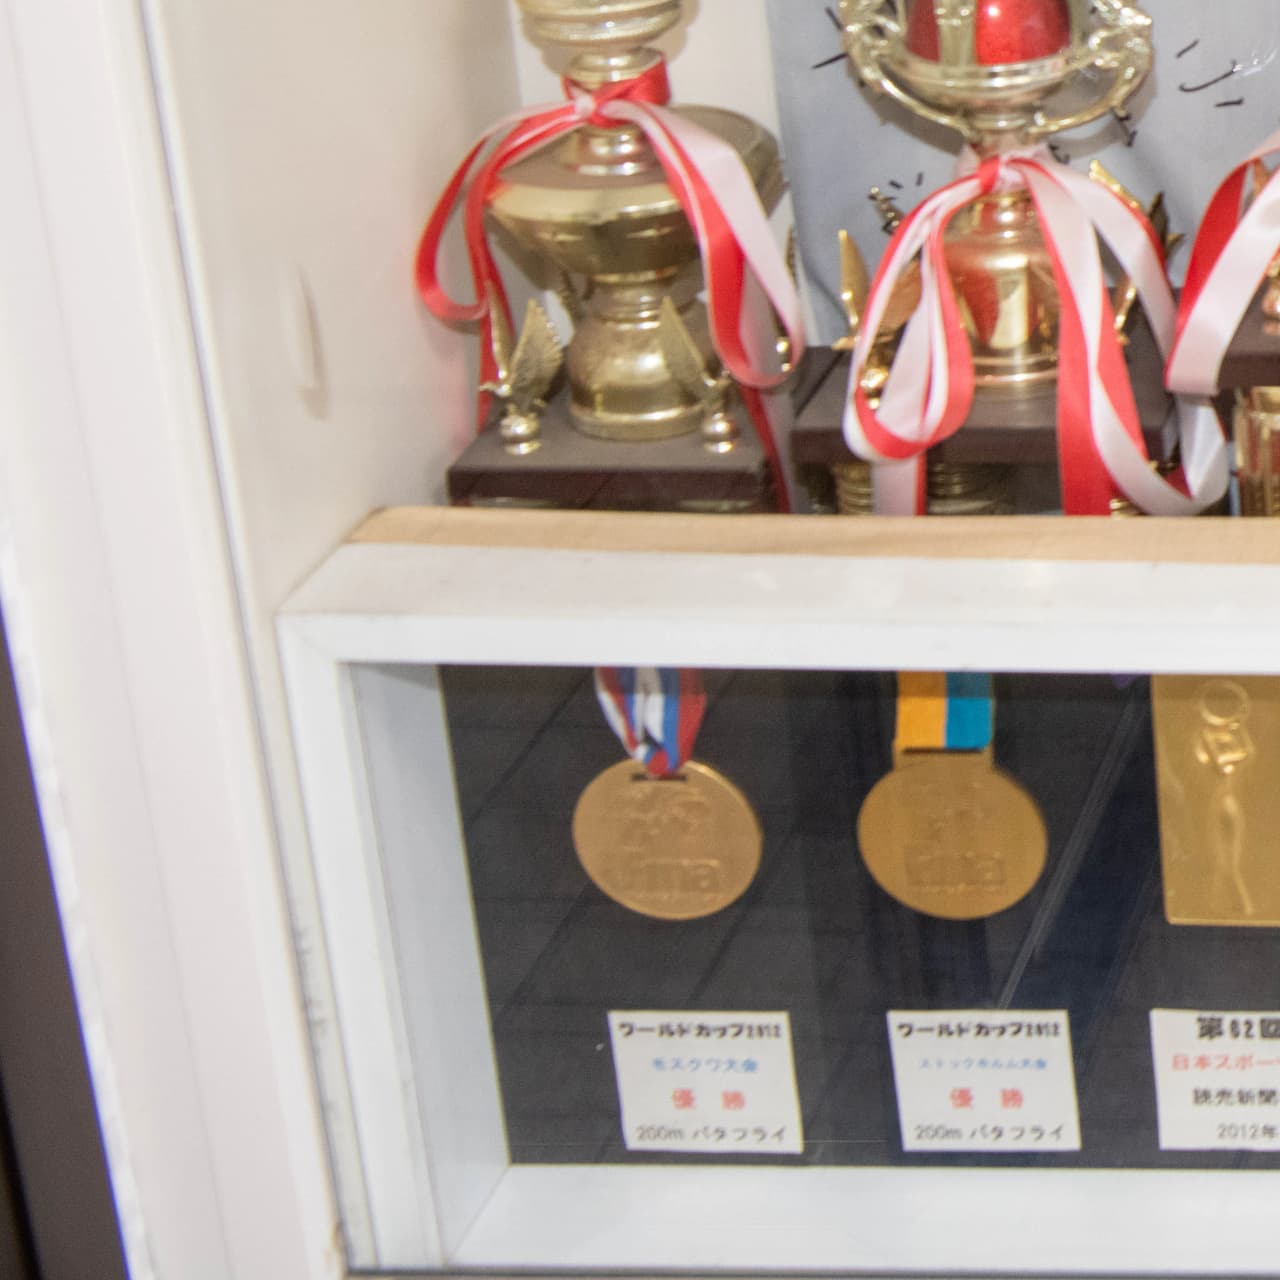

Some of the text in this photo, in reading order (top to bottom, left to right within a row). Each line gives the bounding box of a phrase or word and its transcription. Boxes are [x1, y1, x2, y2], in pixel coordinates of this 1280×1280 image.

[636, 1125, 786, 1142] 200m バタフライ
[914, 1124, 1064, 1141] 200m バタフライ
[1217, 1123, 1278, 1140] 2012年
